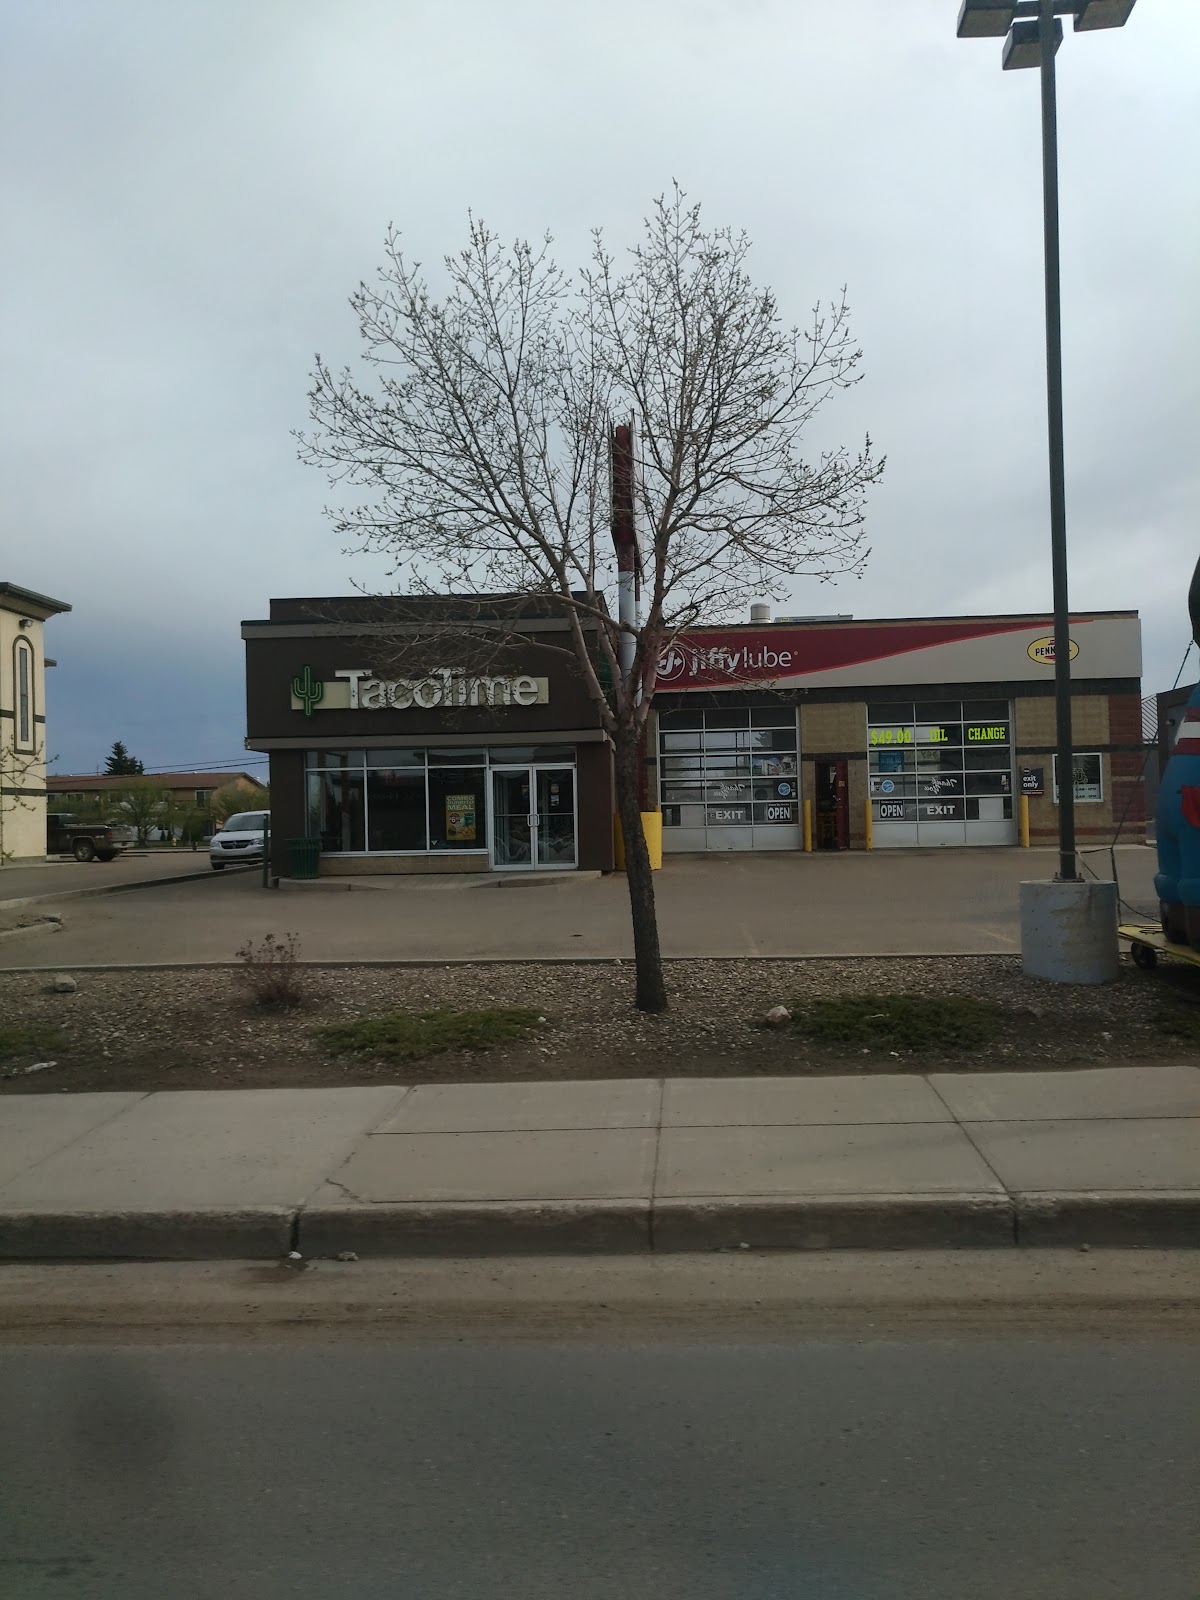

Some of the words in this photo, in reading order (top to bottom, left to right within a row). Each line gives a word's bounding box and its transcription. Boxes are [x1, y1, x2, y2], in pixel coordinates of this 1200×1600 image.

[689, 647, 740, 677] jiffy
[743, 646, 792, 668] lube
[335, 667, 539, 710] TacoTime
[871, 729, 911, 745] $49.00
[929, 728, 948, 742] OIL
[968, 727, 1006, 740] CHANGE
[1022, 781, 1039, 789] only
[715, 810, 743, 820] EXIT
[767, 807, 790, 820] OPEN
[880, 804, 904, 817] OPEN
[926, 805, 956, 815] EXIT
